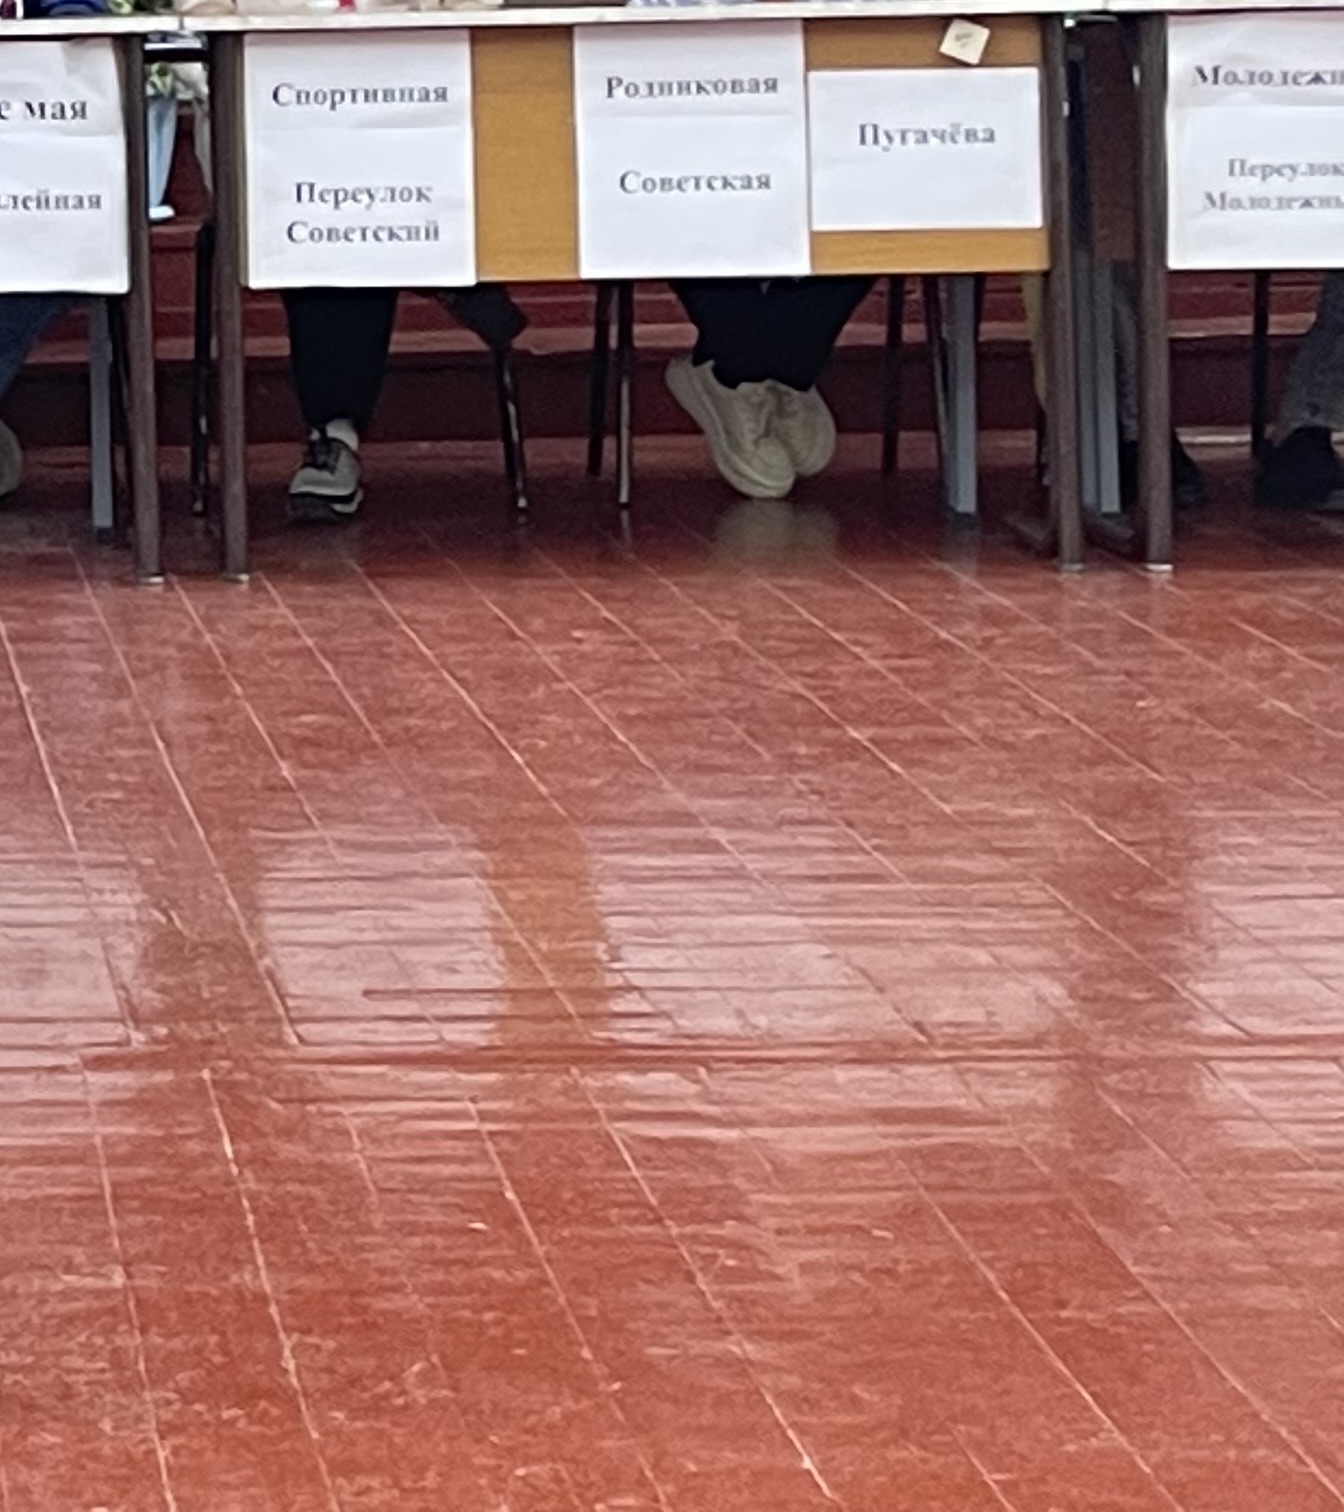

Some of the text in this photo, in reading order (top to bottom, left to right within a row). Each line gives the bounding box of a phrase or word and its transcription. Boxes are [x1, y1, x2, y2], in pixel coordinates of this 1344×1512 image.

[272, 82, 449, 112] Спортивная
[606, 76, 779, 99] Родниковая
[25, 101, 88, 121] мая
[859, 123, 997, 152] Пугачёва
[619, 169, 772, 195] Советская
[296, 182, 433, 209] Переулок
[286, 219, 441, 245] Советский
